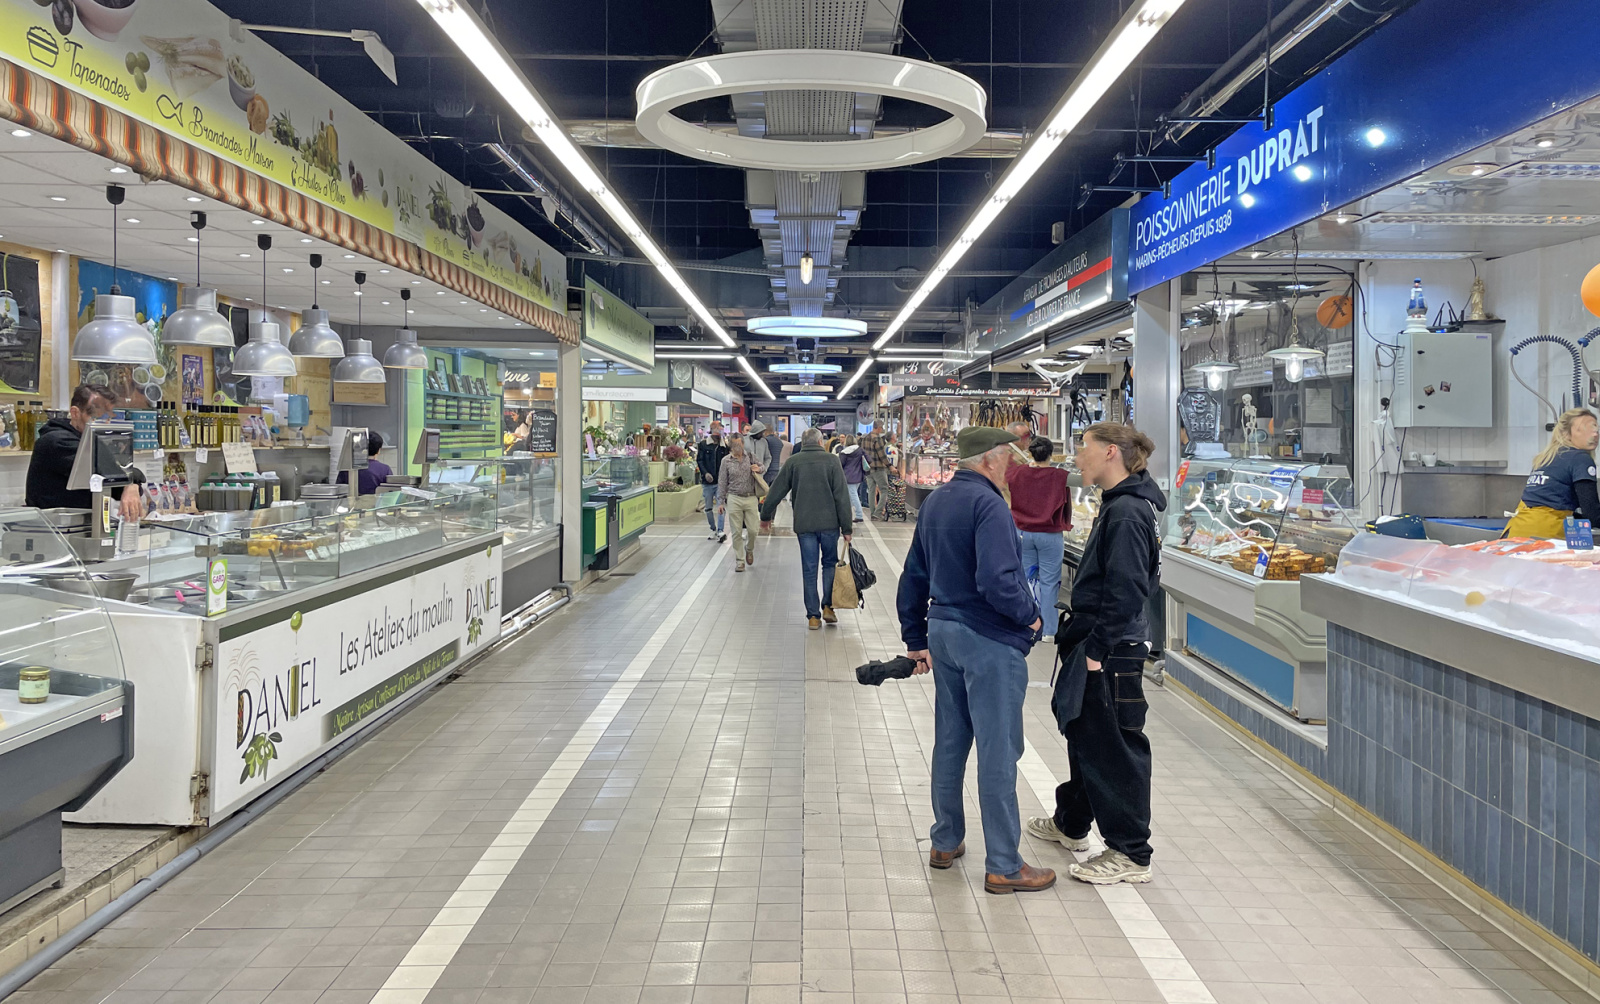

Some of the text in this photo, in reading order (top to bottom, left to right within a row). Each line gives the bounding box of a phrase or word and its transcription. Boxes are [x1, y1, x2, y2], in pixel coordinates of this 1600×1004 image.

[64, 37, 131, 101] Tapenades
[188, 106, 274, 171] Brandades Maison
[1136, 105, 1324, 250] POISSONNERIE DUPRAT
[1190, 218, 1214, 246] DEPUIS
[1215, 209, 1232, 234] 1938
[1044, 265, 1063, 290] FROMAGES
[1058, 297, 1063, 313] DE
[1064, 289, 1080, 310] FRANCE
[213, 574, 225, 583] GARD
[466, 576, 499, 624] DANIEL
[340, 582, 453, 675] Les Ateliers du moulin
[237, 657, 322, 750] DANIEL
[355, 698, 374, 721] Artisan
